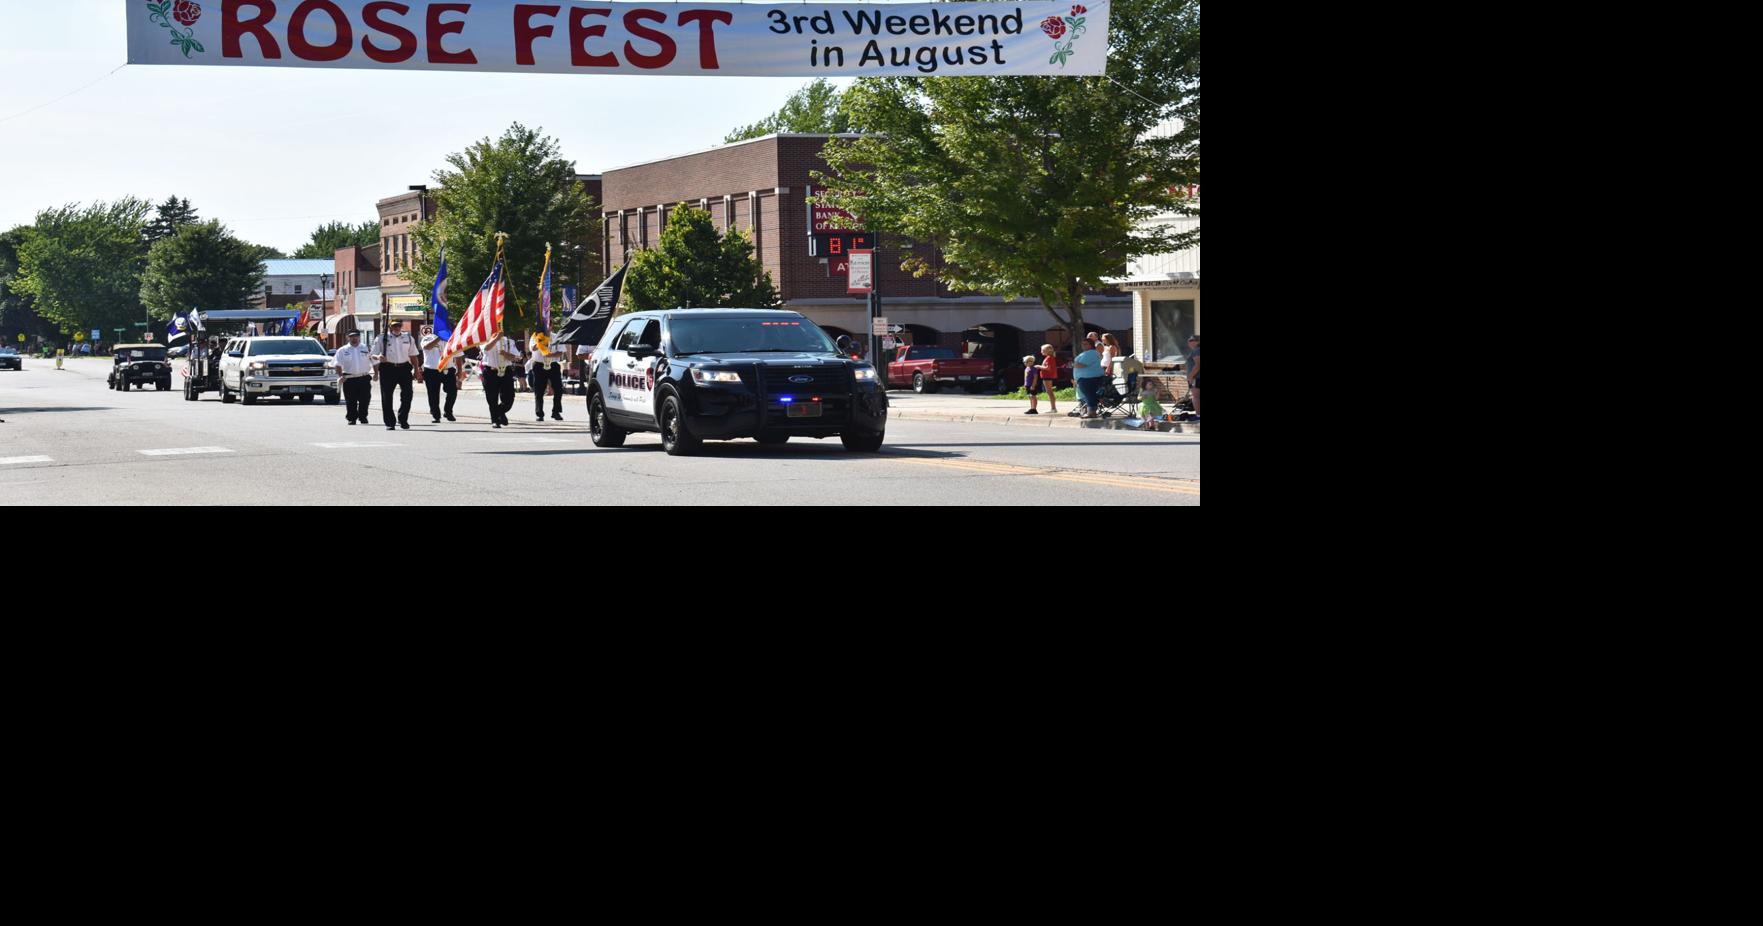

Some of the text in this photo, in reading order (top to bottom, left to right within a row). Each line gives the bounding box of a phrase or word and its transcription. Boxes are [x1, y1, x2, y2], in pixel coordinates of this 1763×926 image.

[221, 0, 733, 69] ROSE FEST
[767, 8, 1023, 35] 3rd Weekend
[810, 39, 1006, 73] in August
[608, 371, 646, 391] POLICE
